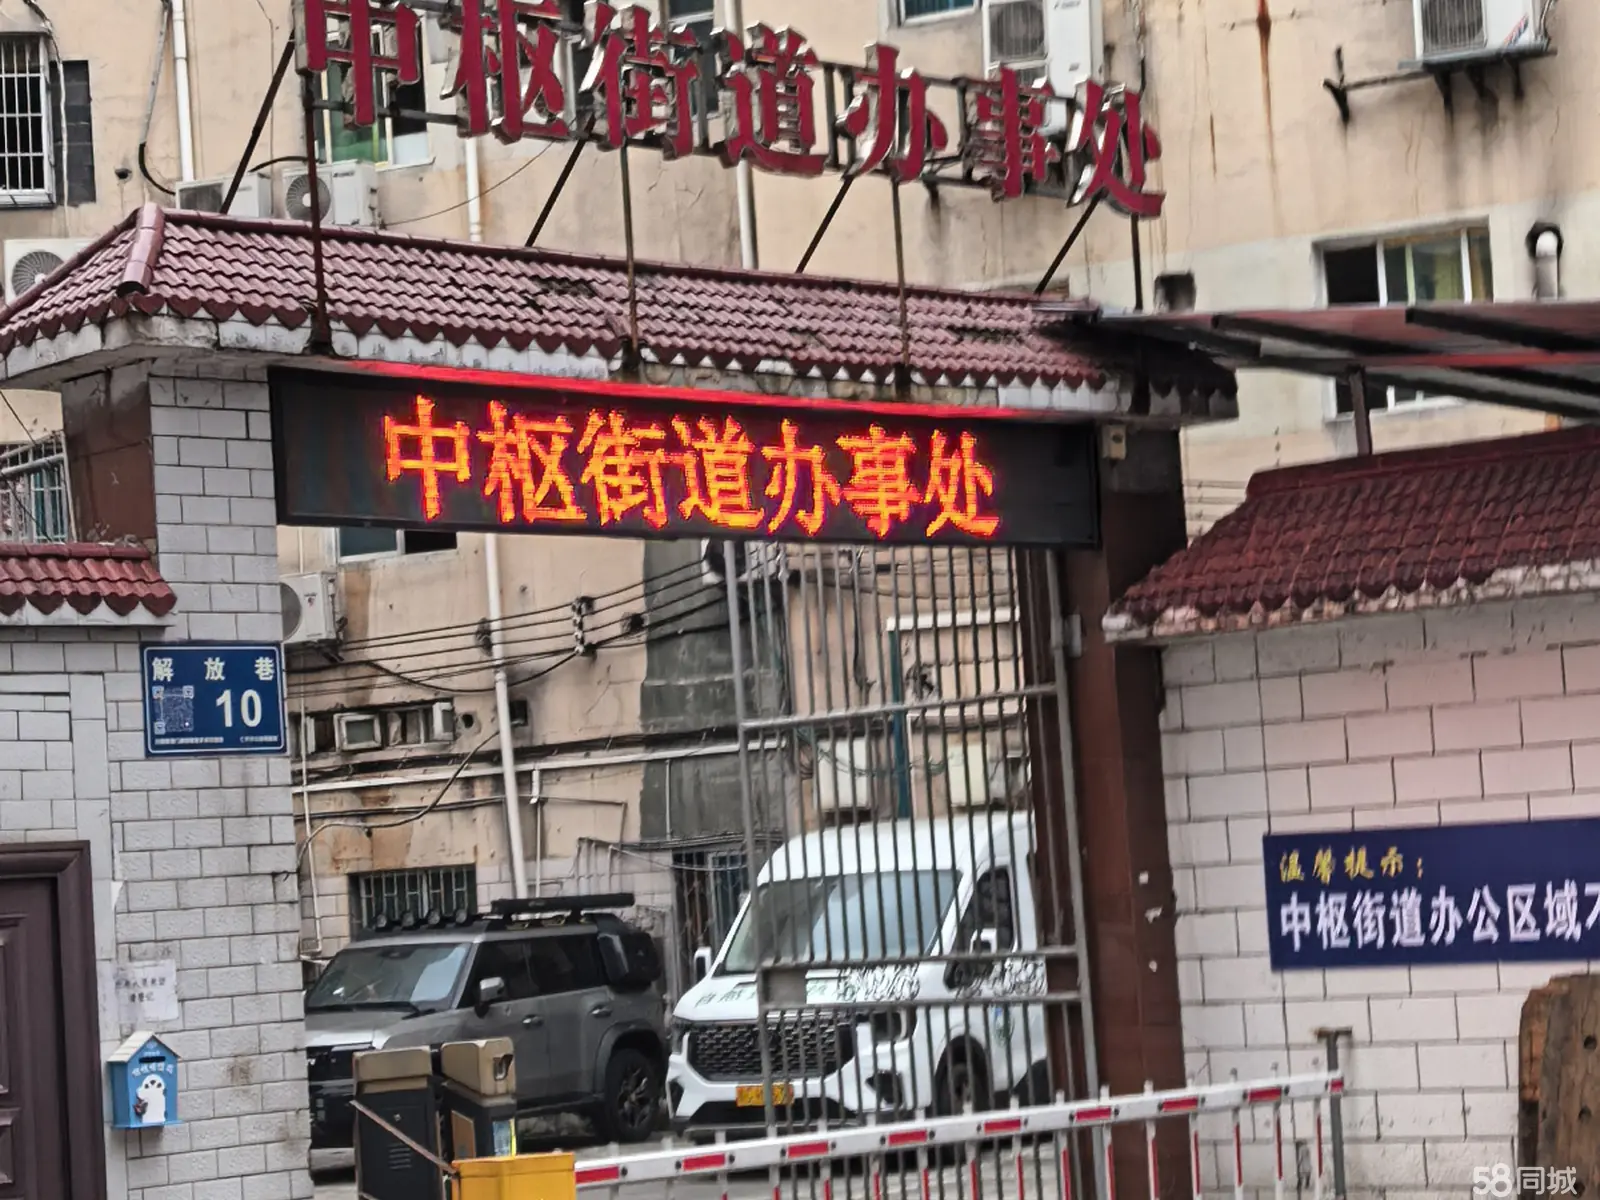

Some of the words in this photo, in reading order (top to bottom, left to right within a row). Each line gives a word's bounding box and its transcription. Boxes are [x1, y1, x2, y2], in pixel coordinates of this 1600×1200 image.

[297, 0, 1164, 217] 中枢街道办事处
[383, 394, 1000, 538] 中枢街道办事处
[152, 656, 275, 682] 解放巷
[215, 688, 262, 728] 10
